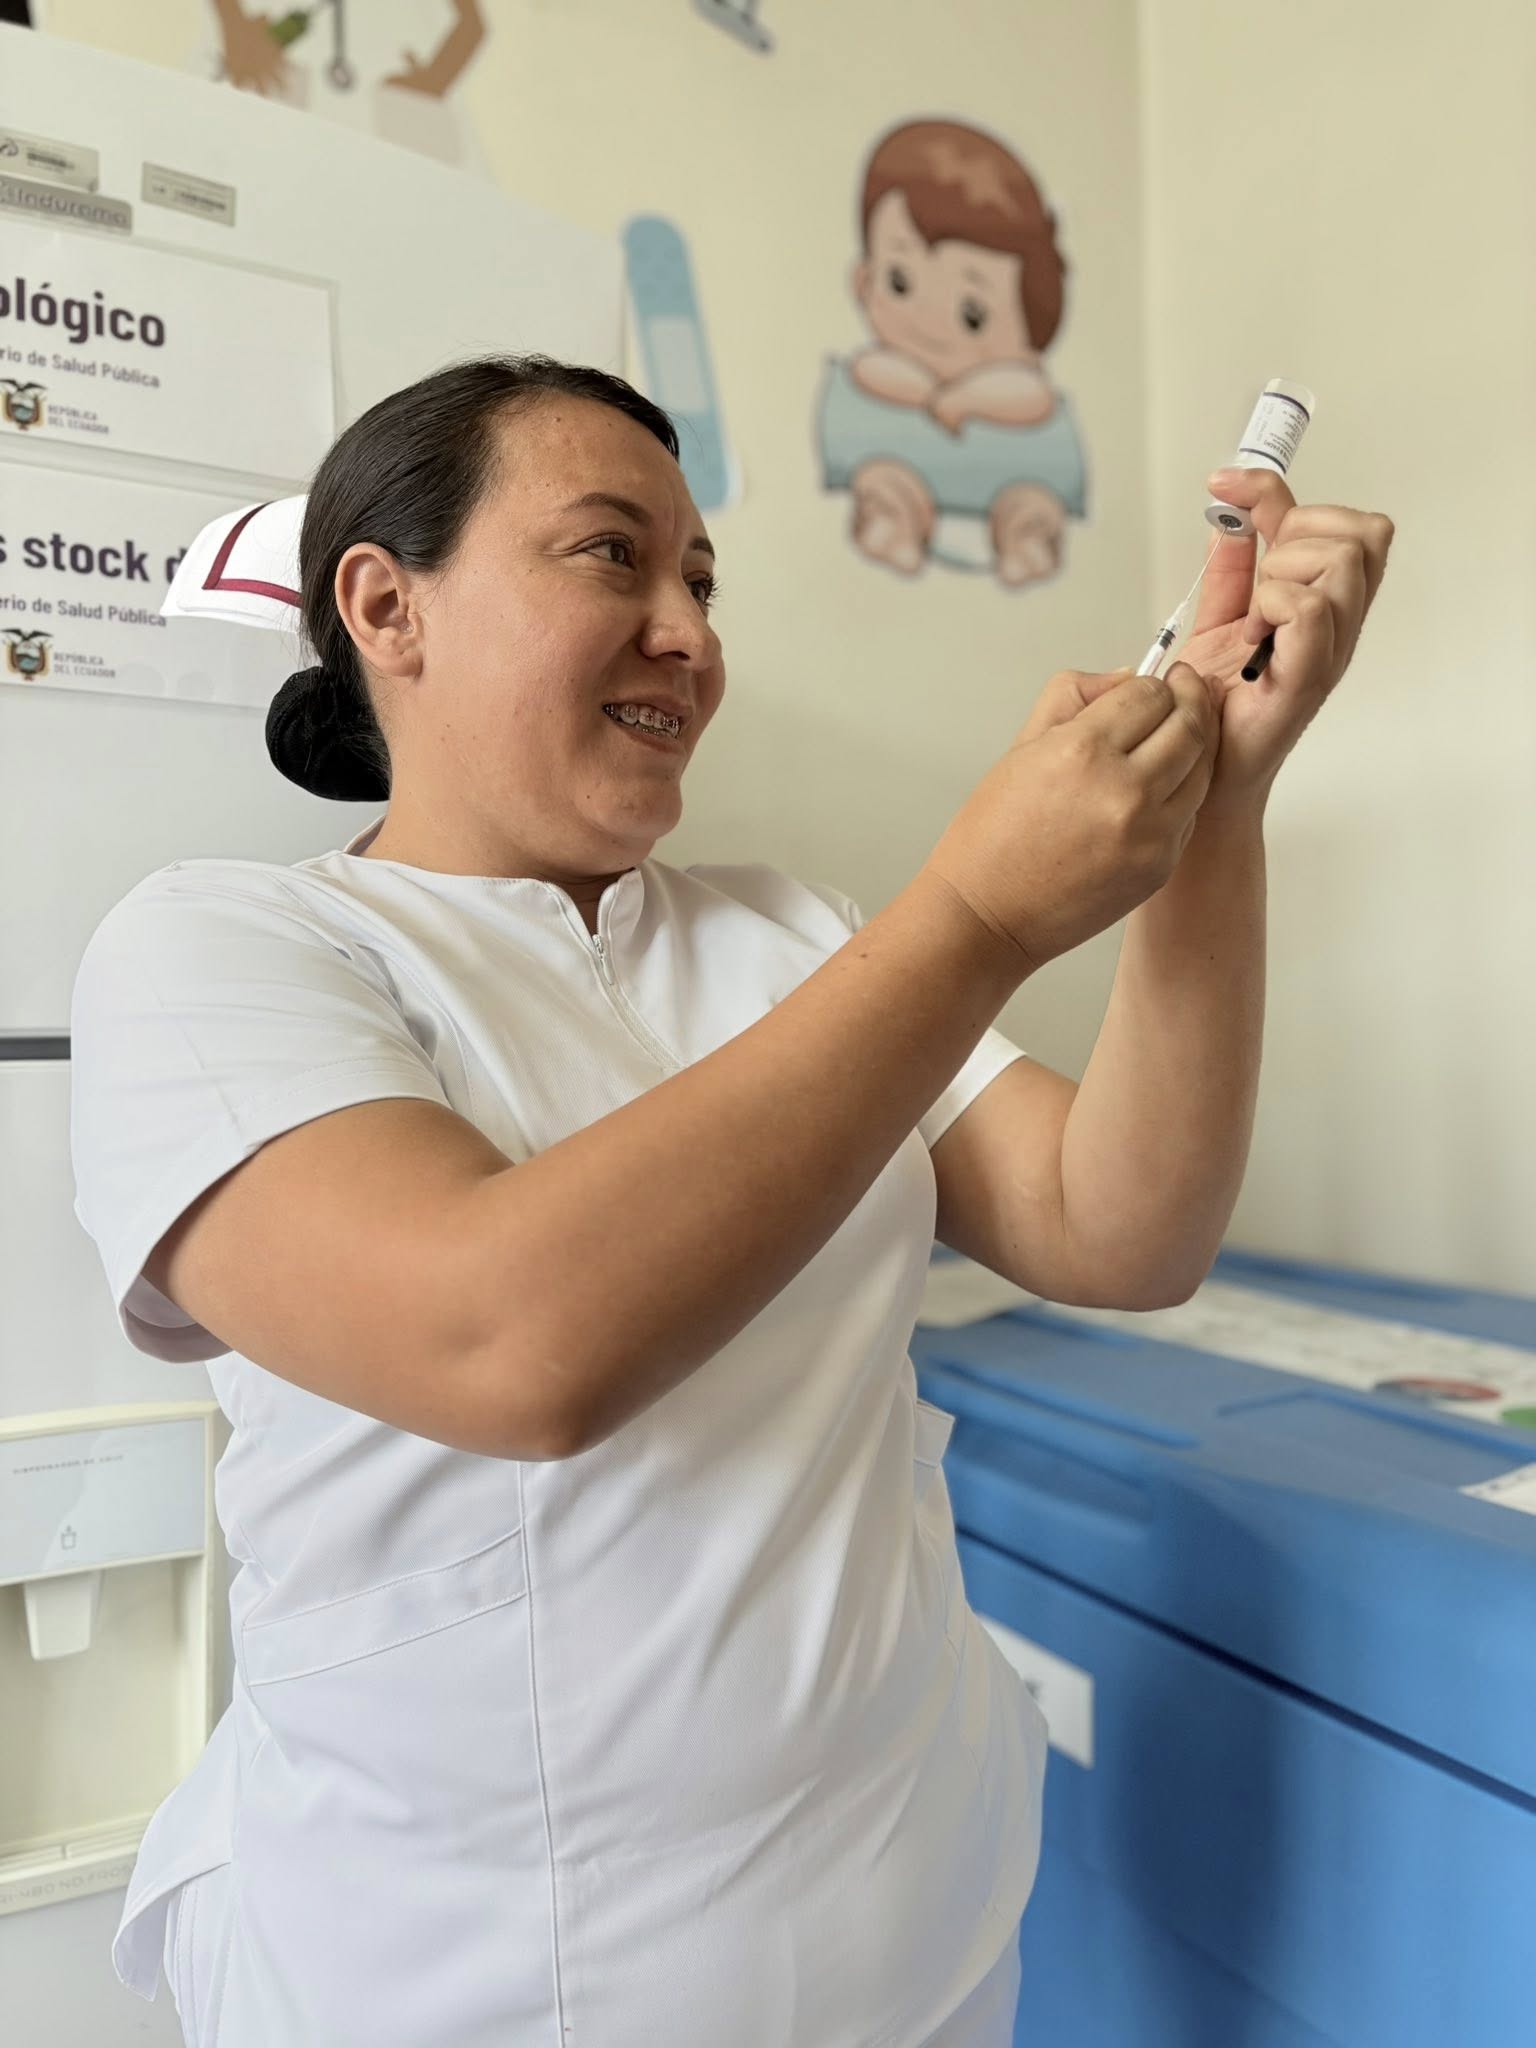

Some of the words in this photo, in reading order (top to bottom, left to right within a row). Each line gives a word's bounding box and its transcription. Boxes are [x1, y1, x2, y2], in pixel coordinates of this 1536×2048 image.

[28, 349, 47, 367] de
[52, 354, 97, 377] Salud
[101, 362, 160, 389] Pública
[23, 532, 151, 583] stock
[32, 597, 52, 613] de
[57, 599, 103, 620] Salud
[108, 605, 167, 628] Pública
